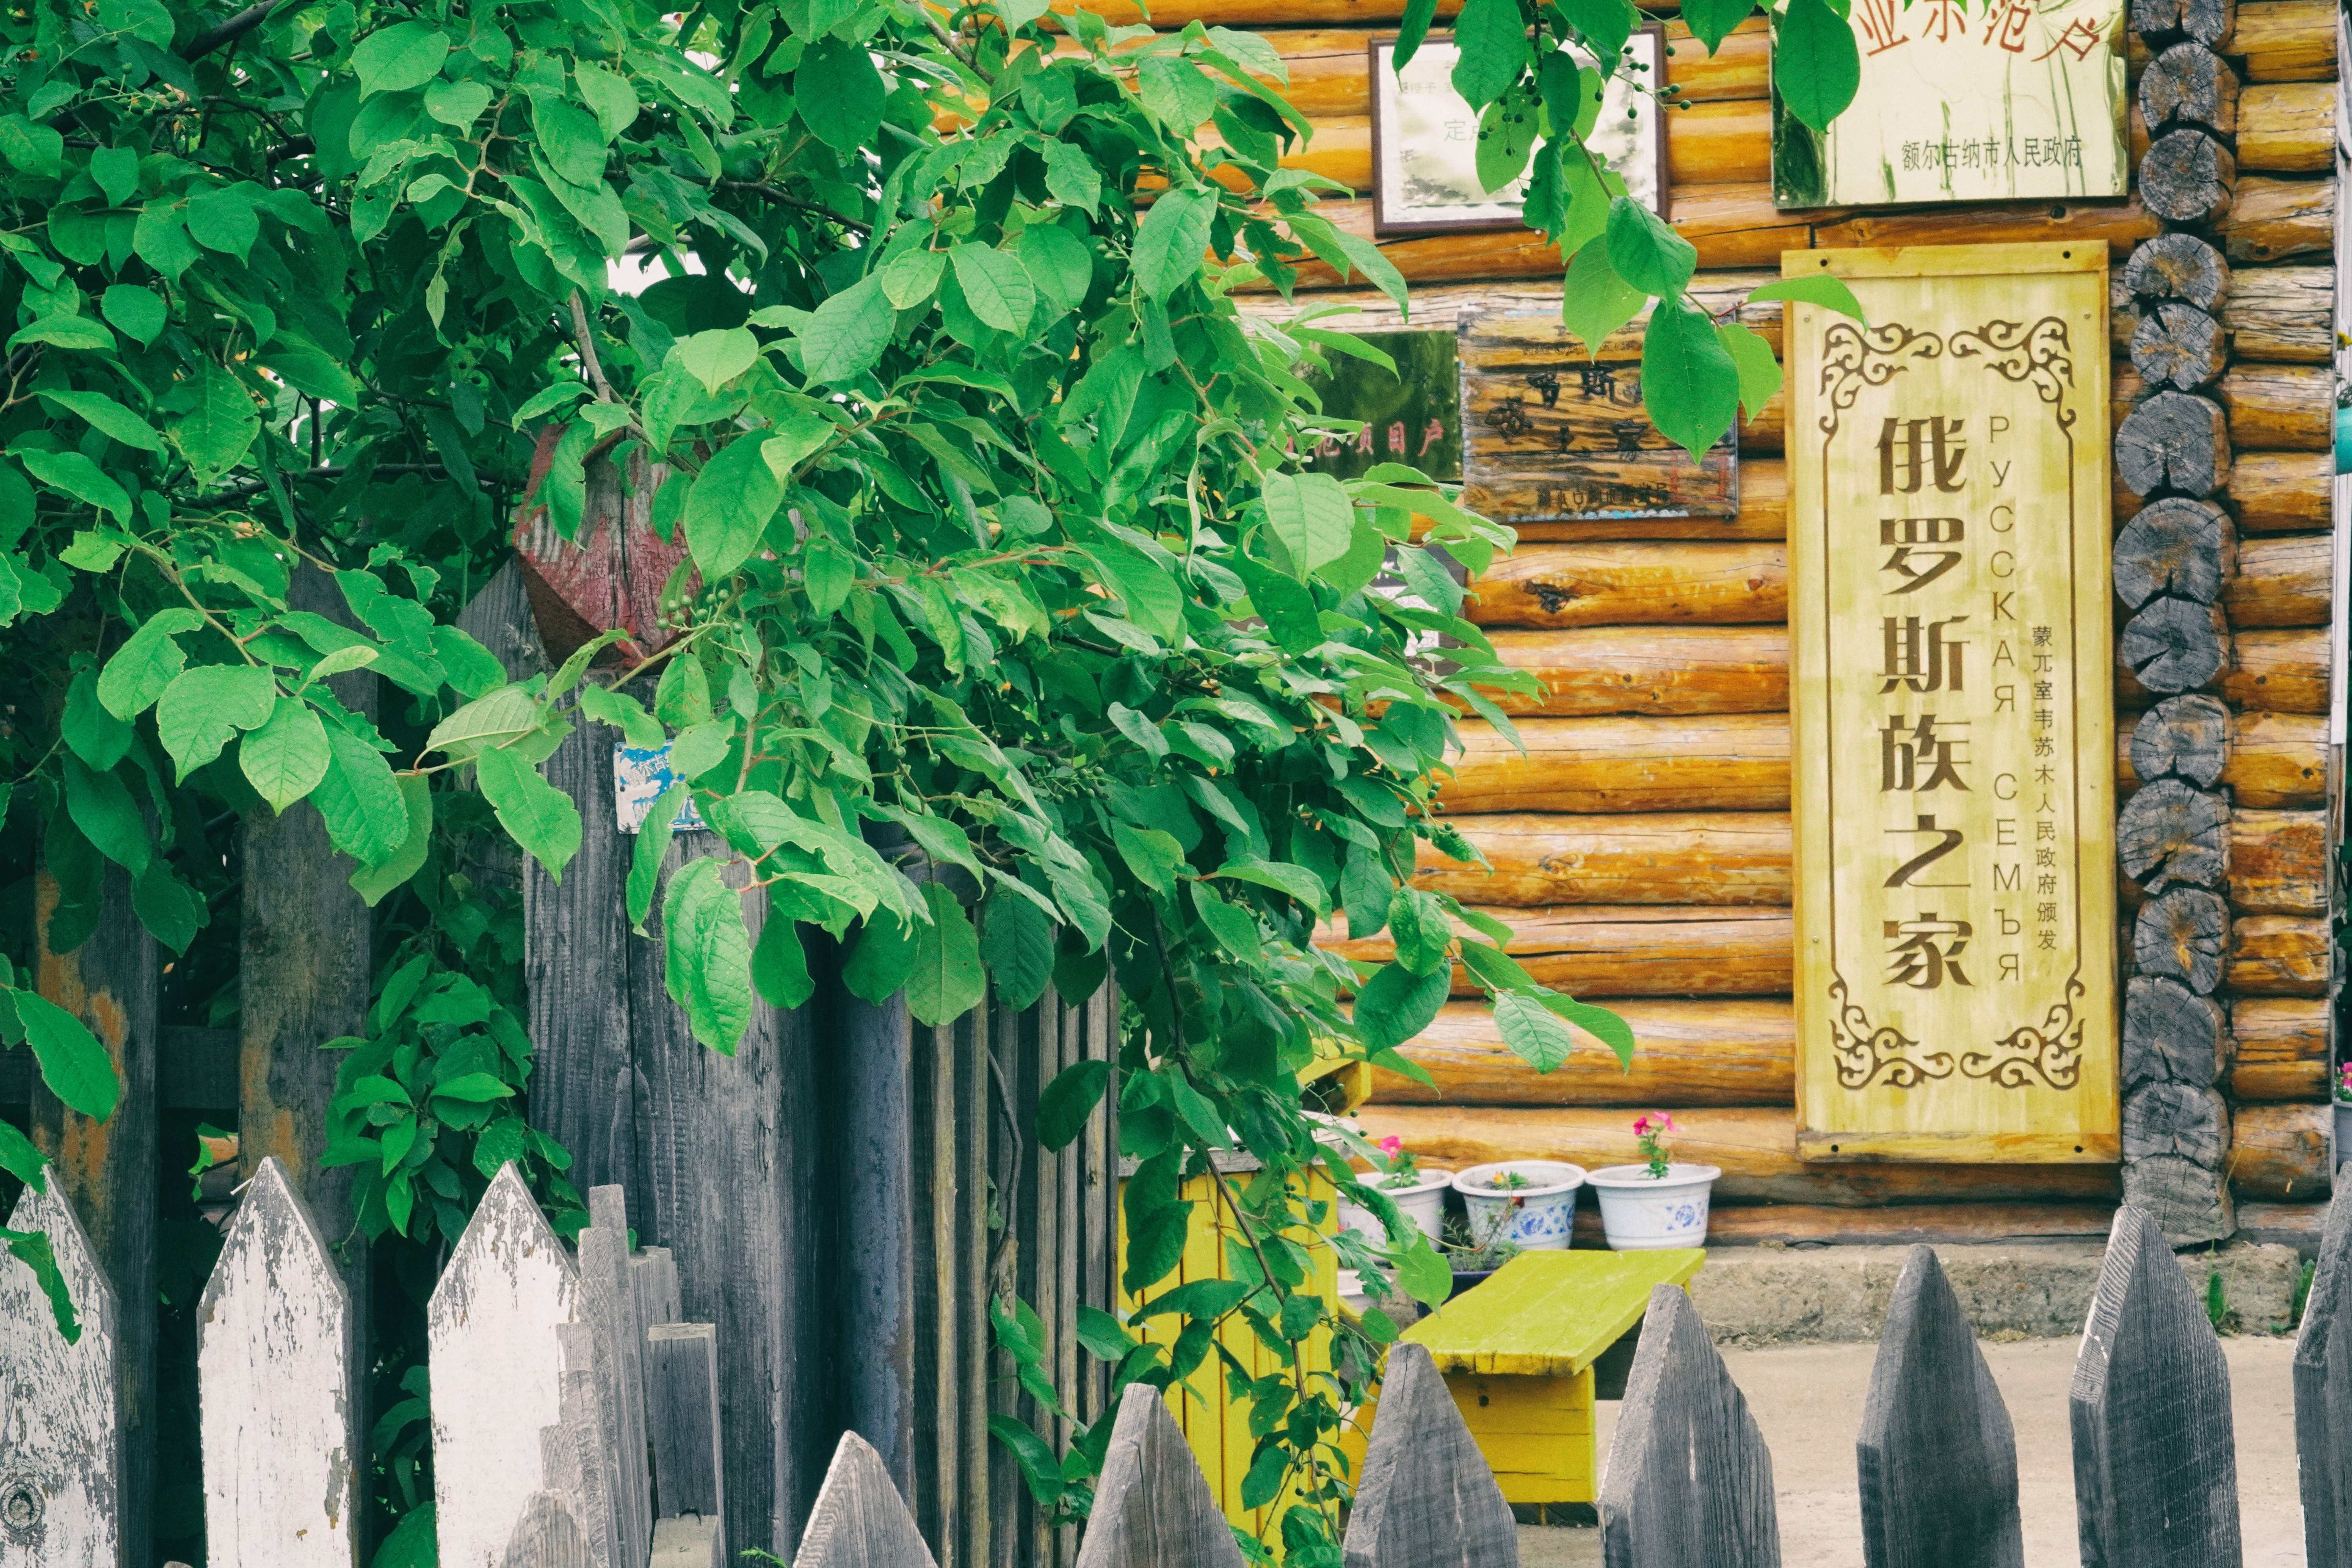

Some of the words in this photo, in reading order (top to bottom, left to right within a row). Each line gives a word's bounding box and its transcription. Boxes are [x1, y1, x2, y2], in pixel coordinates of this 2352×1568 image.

[1902, 134, 2082, 172] 额尔古纳市人民政府
[1875, 415, 1974, 989] 俄罗斯族之家
[1989, 416, 2016, 713] РУССКАЯ
[2032, 626, 2057, 951] 蒙兀室韦苏木人民政府颁发
